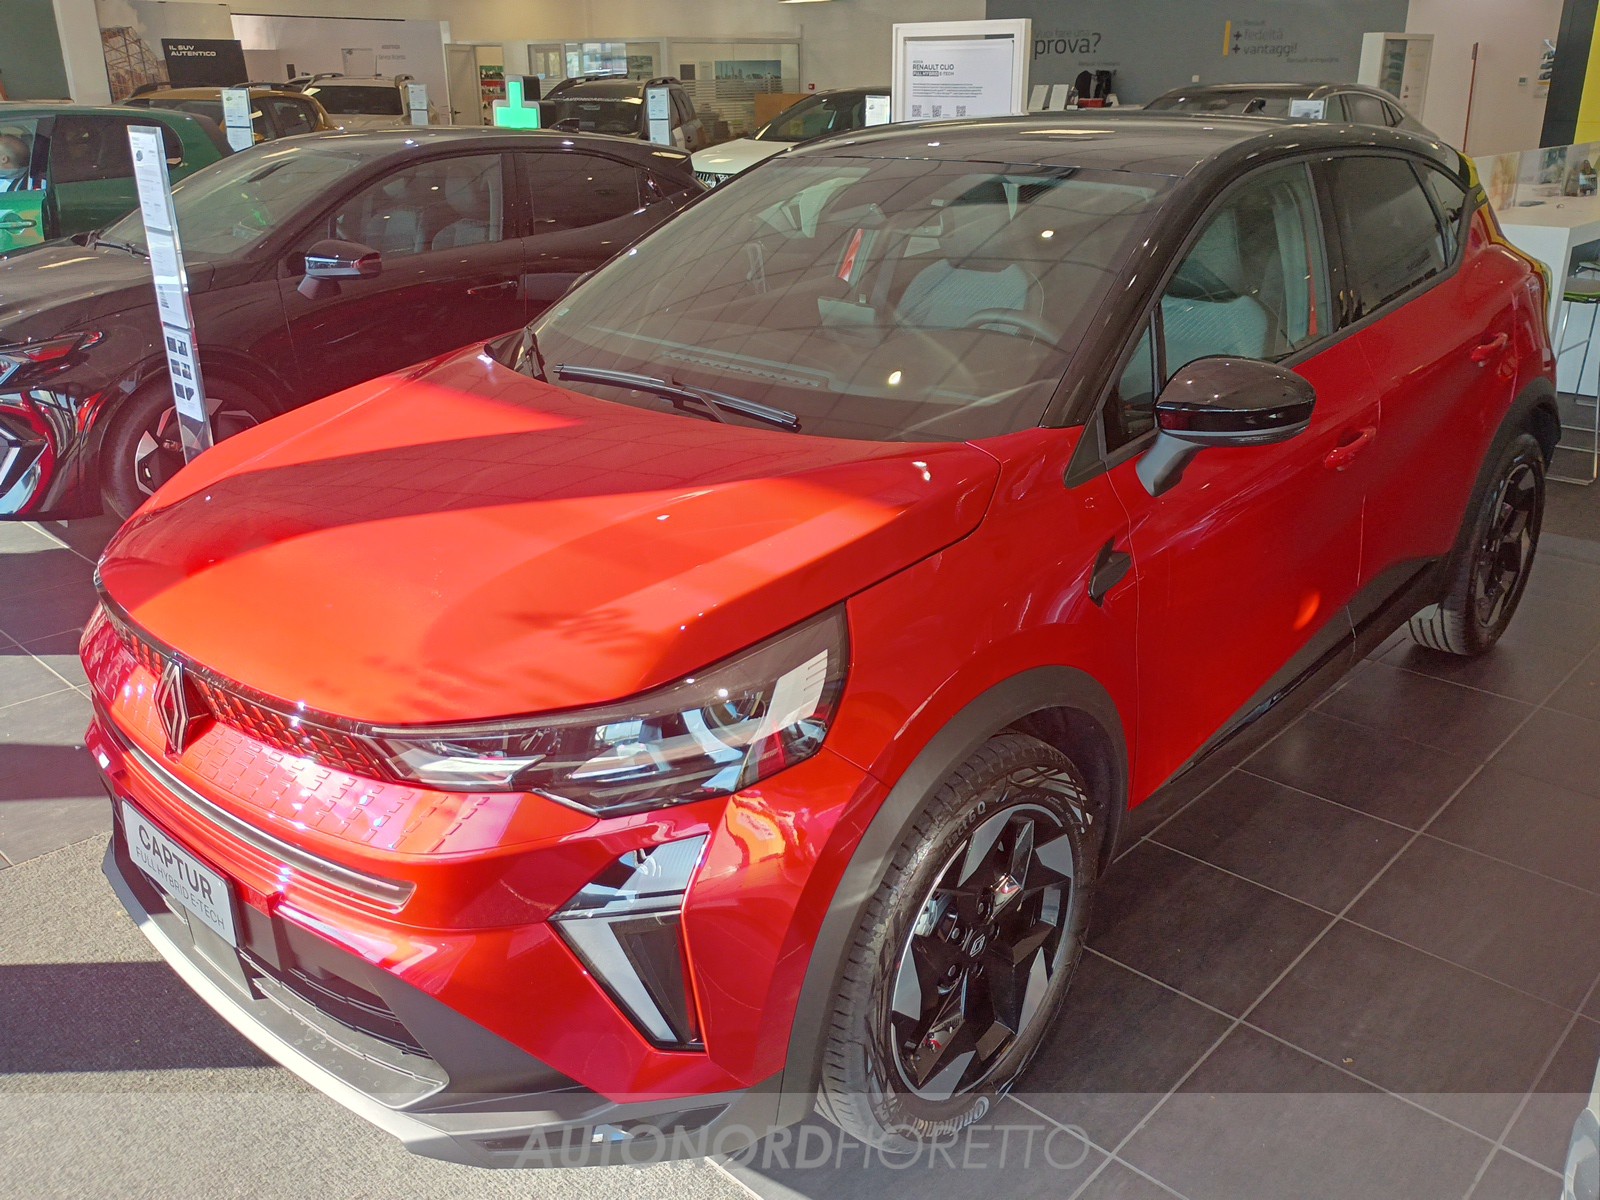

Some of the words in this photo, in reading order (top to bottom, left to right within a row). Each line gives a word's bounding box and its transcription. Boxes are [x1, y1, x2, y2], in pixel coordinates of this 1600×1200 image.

[1034, 32, 1102, 60] prova?
[135, 846, 157, 873] FULL
[157, 866, 190, 899] HYBRID
[190, 892, 226, 930] E-TECH
[138, 824, 215, 905] CAPTUR
